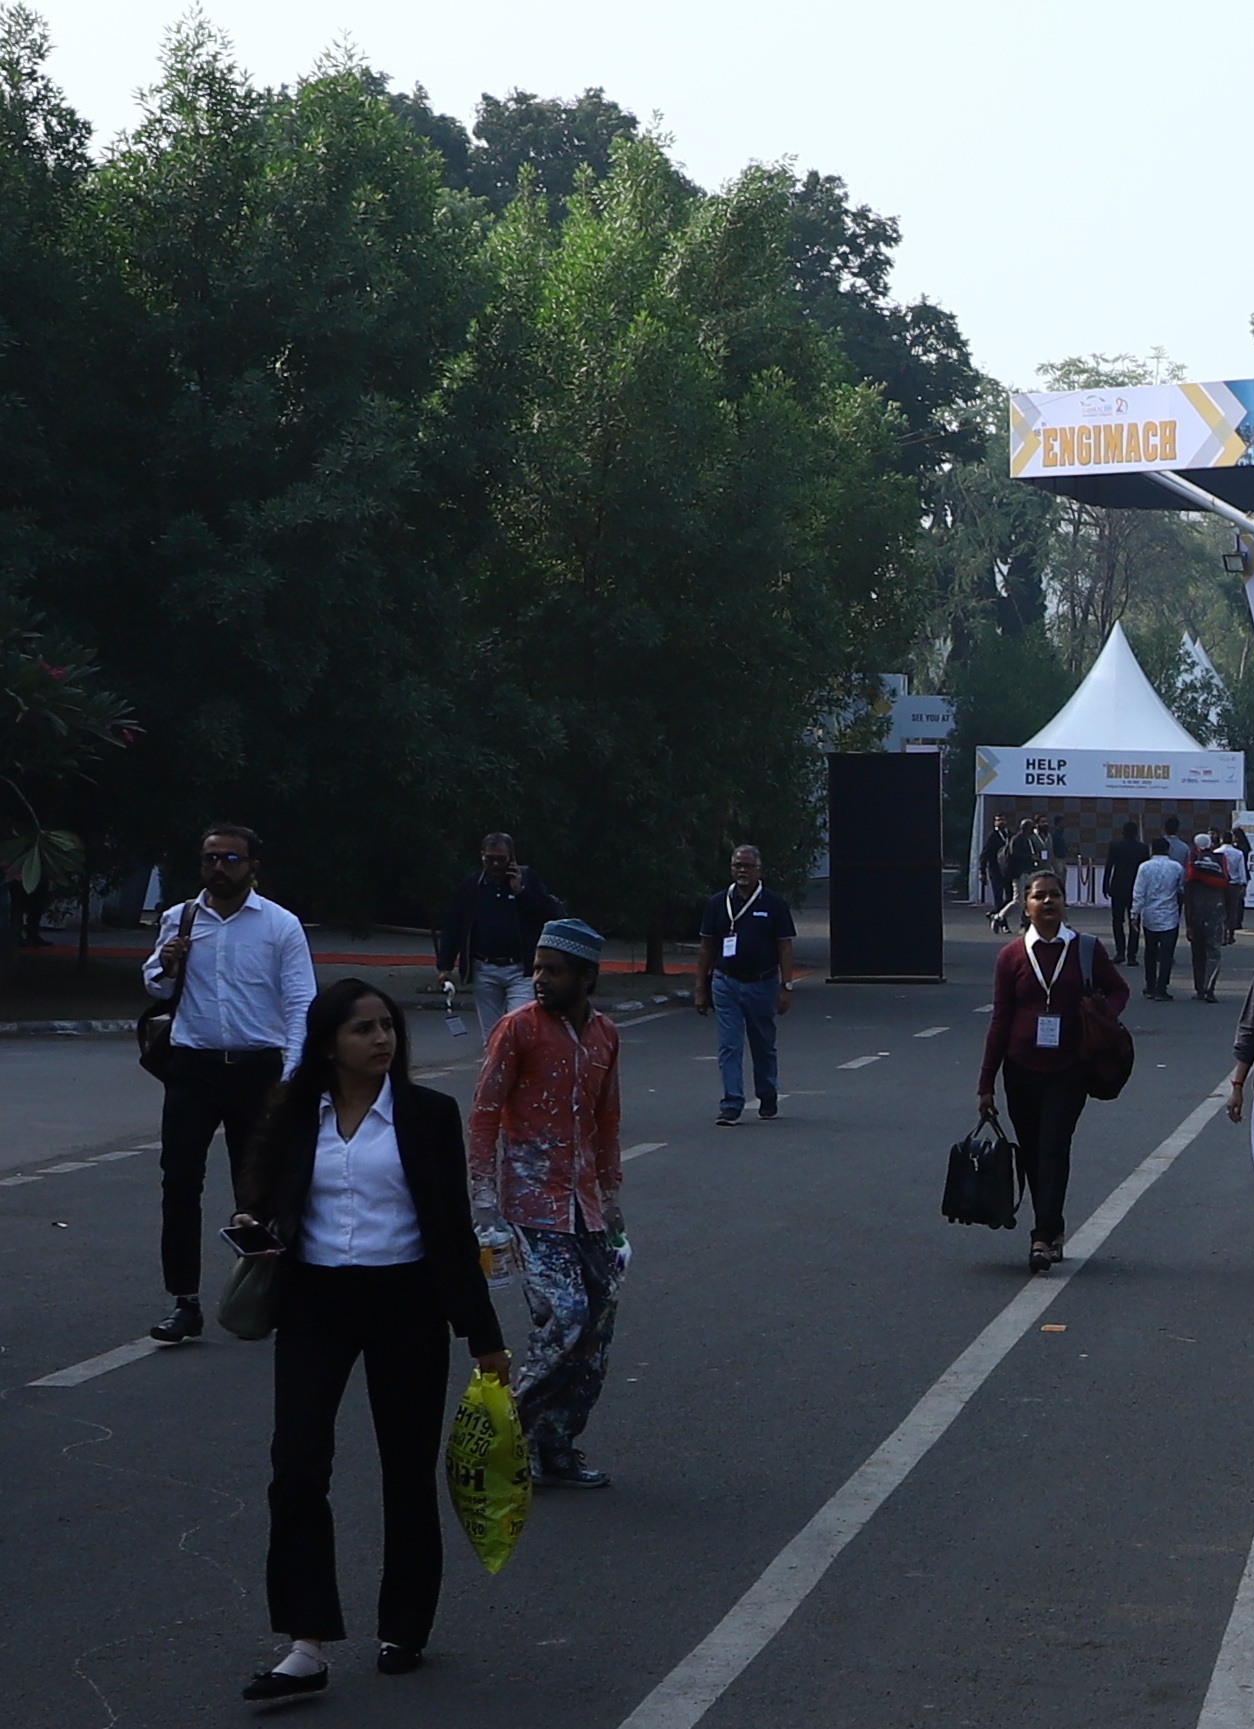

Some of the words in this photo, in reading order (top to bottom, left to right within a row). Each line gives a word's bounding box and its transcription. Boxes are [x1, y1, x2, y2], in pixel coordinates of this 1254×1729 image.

[1042, 420, 1177, 468] ENGIMACH
[1026, 758, 1067, 771] HELP
[1025, 773, 1067, 786] DESK
